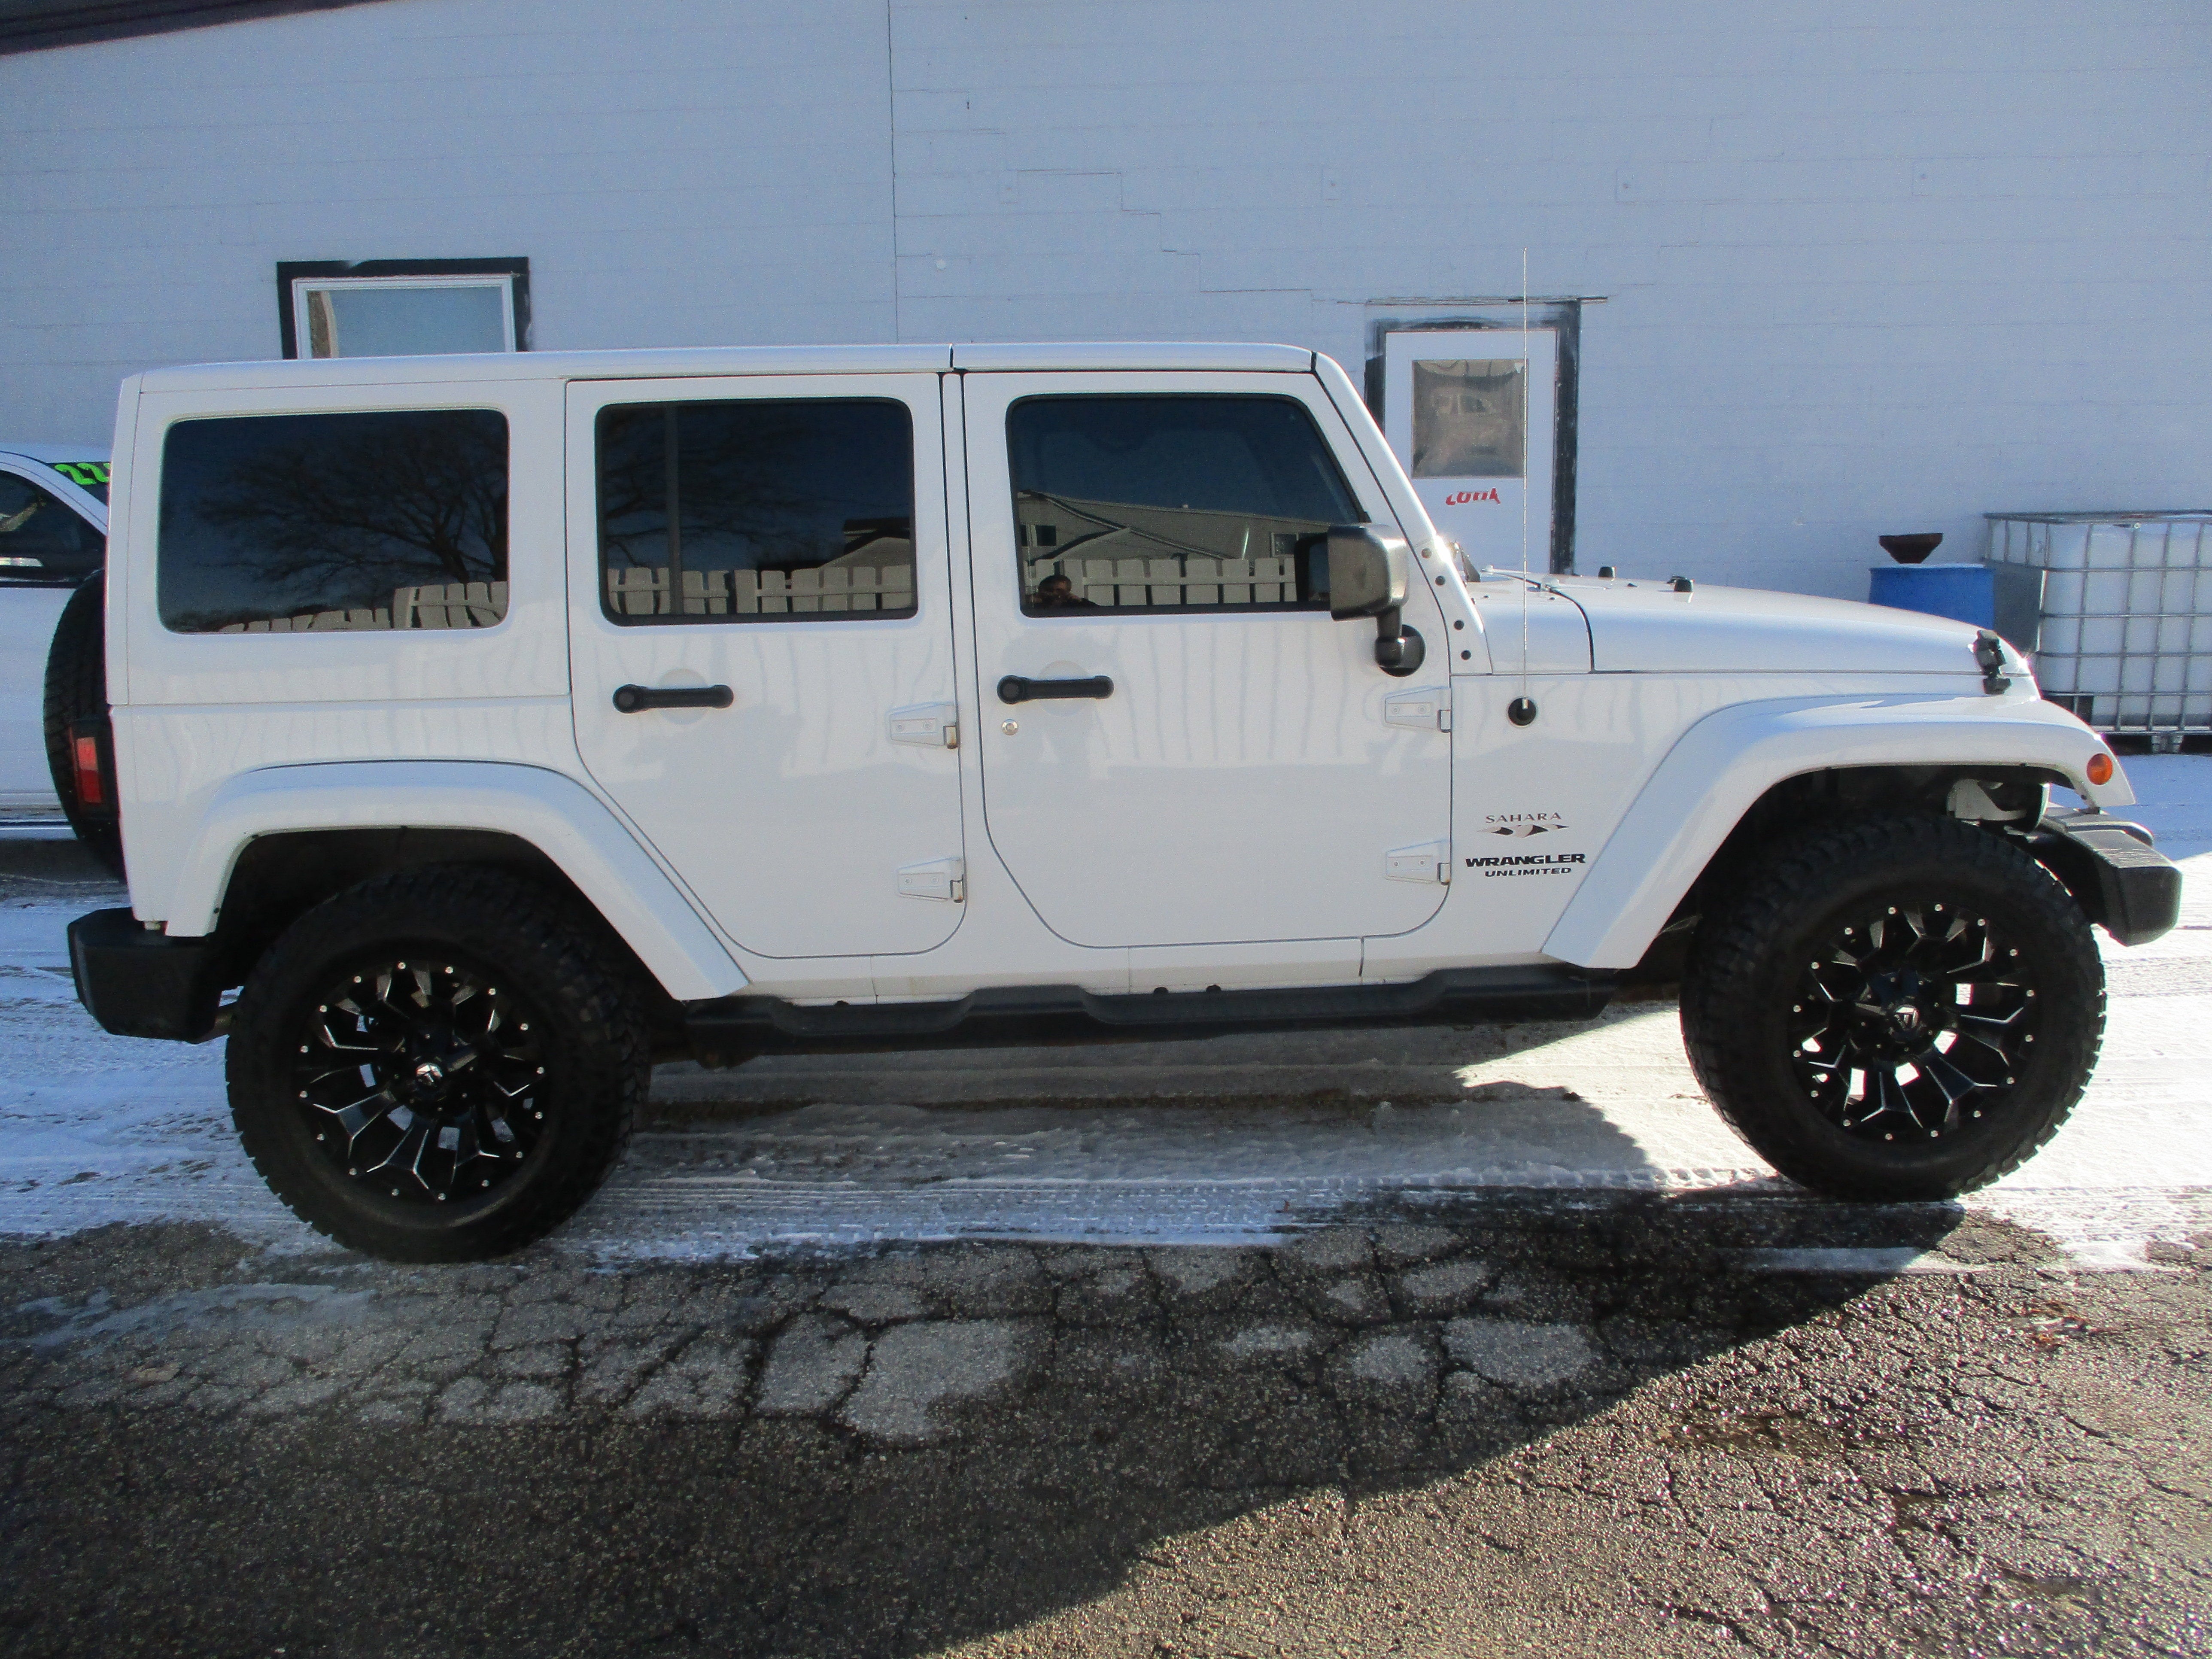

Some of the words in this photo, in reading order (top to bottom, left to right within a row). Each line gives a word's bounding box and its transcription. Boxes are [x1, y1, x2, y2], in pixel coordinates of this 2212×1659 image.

[1486, 812, 1562, 823] SAHARA
[1465, 853, 1586, 867] WRANGLER
[1485, 867, 1571, 877] UNLIMITED
